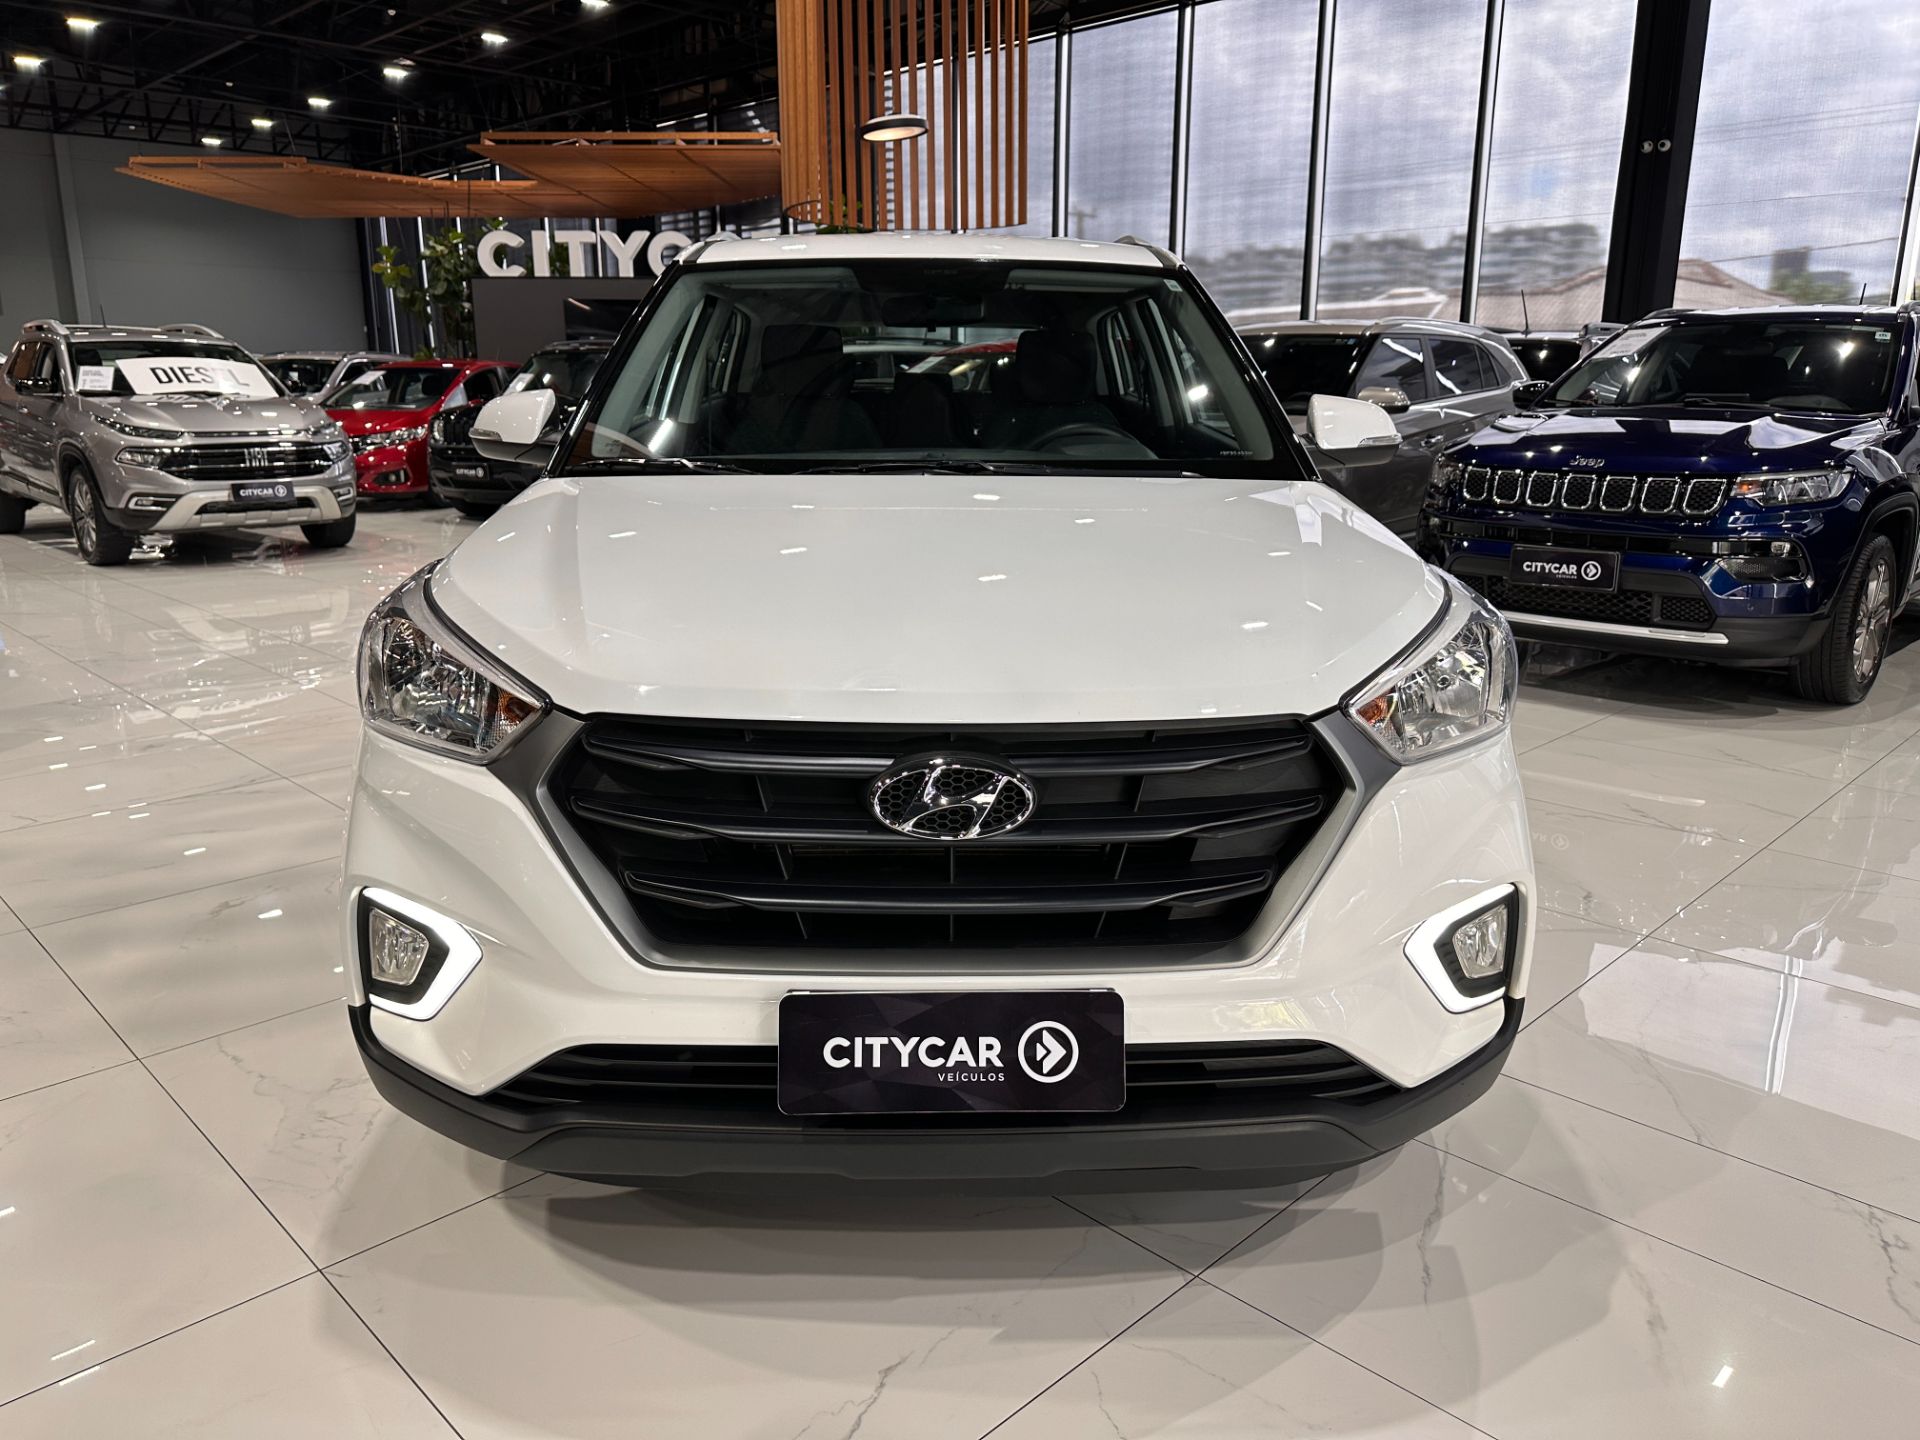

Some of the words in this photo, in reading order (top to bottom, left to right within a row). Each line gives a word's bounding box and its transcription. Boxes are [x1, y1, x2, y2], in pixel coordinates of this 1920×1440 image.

[150, 366, 250, 387] DIESL
[1569, 454, 1605, 468] Jeep
[1522, 561, 1577, 575] CITYCAR
[823, 1036, 1004, 1068] CITYCAR
[938, 1071, 1005, 1082] VEÍCULOS
